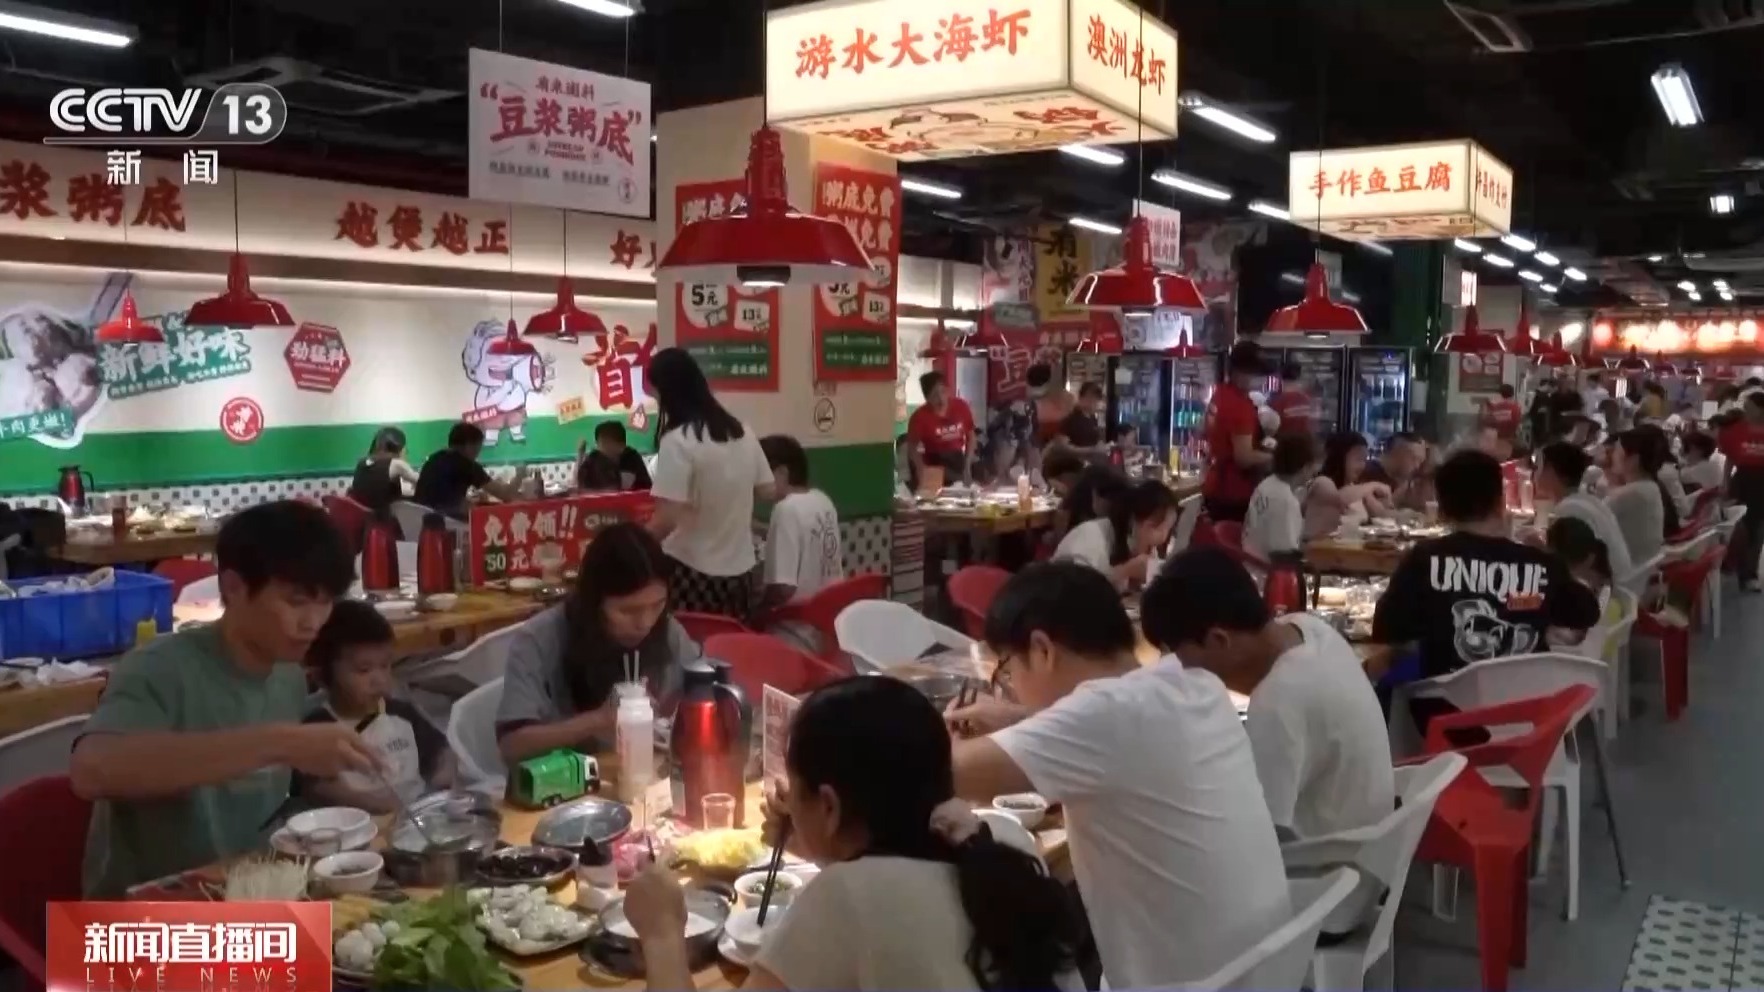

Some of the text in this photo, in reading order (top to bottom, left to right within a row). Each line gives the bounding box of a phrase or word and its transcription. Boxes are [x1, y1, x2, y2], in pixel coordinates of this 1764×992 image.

[796, 9, 1031, 80] 游水大海虾
[1086, 13, 1167, 95] 澳洲龙虾
[1309, 161, 1453, 198] 手作鱼豆腐
[333, 201, 509, 256] 越煲越正
[610, 229, 655, 269] 好
[1430, 555, 1548, 603] UNIQUE
